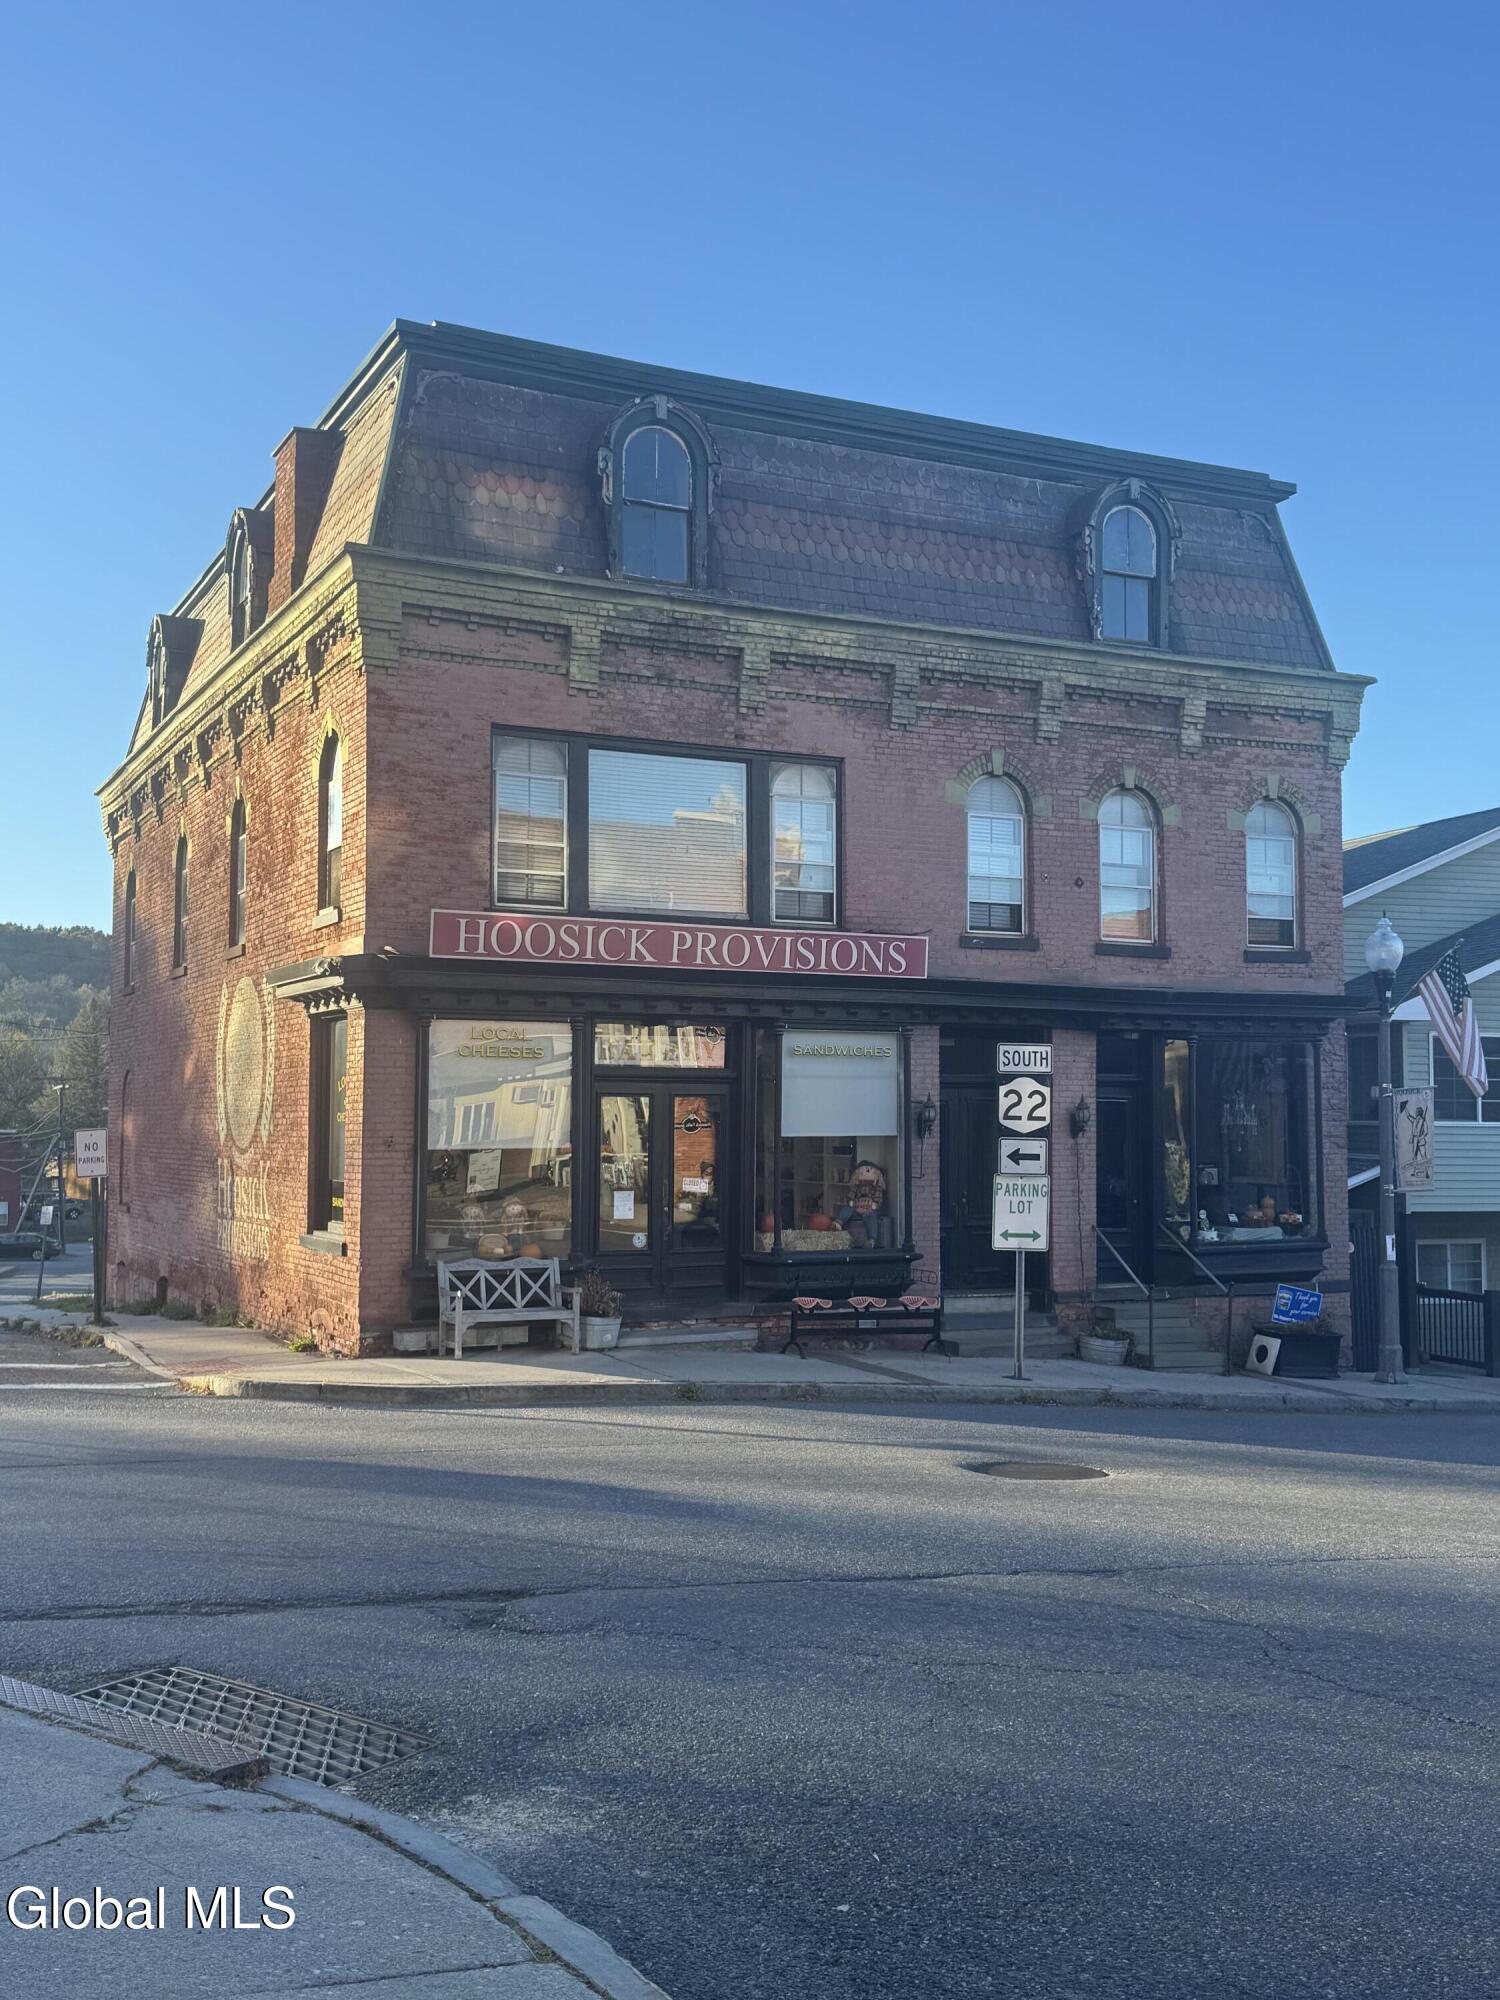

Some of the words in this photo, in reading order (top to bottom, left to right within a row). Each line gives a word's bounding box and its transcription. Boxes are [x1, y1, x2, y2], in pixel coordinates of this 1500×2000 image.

[454, 918, 658, 963] HOOSICK
[668, 930, 908, 974] PROVISIONS
[471, 1025, 532, 1042] LOCAL
[458, 1043, 545, 1060] CHEESES
[793, 1043, 893, 1058] SANDWICHES
[1002, 1050, 1049, 1069] SOUTH
[1002, 1088, 1047, 1122] 22
[84, 1142, 99, 1152] NO
[78, 1155, 105, 1165] PARKING
[995, 1182, 1048, 1198] PARKING
[1009, 1200, 1033, 1214] LOT
